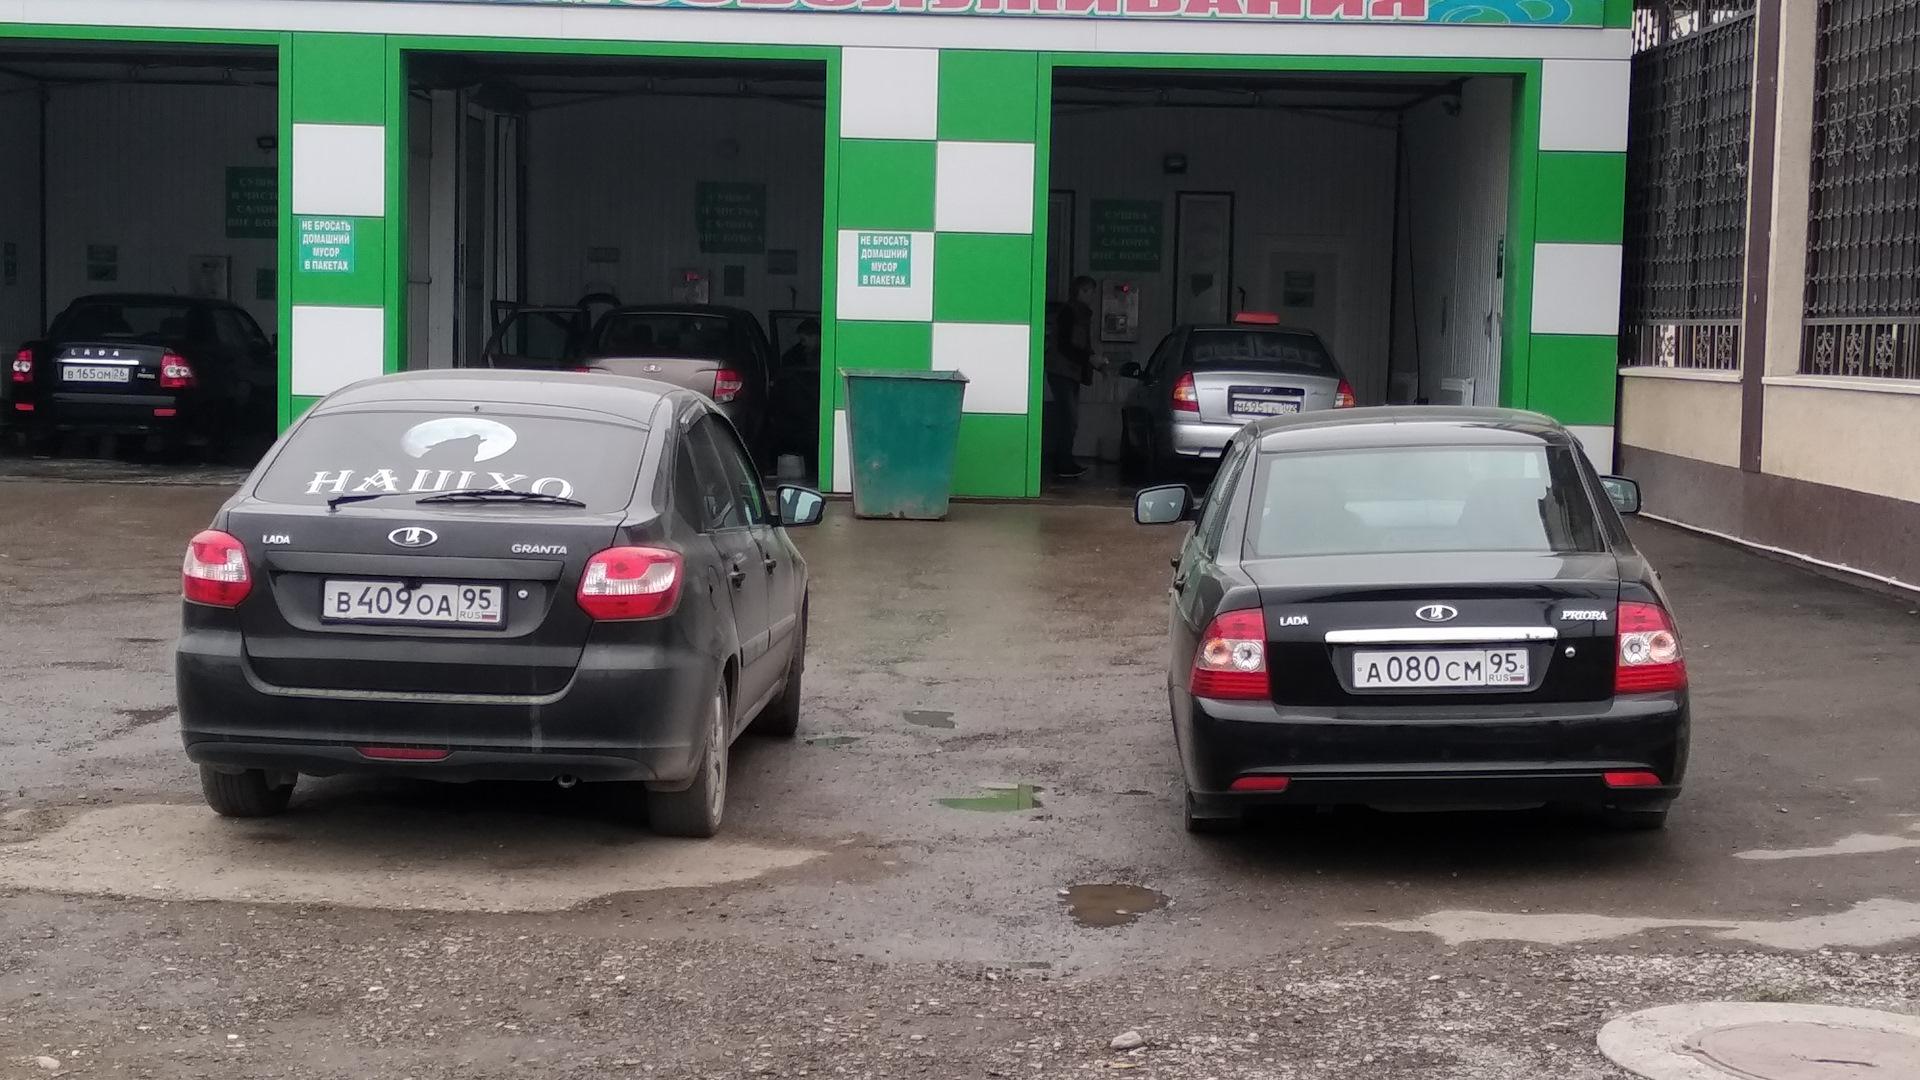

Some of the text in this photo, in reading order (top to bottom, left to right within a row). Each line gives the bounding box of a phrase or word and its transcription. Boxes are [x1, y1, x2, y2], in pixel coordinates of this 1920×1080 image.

[302, 220, 351, 232] НЕ БРОСАТЬ
[302, 232, 350, 245] ДОМАШНИЙ
[860, 235, 909, 246] НЕ БРОСАТЬ
[312, 247, 340, 257] МУСОР
[861, 247, 908, 260] ДОМАШНИЙ
[304, 260, 348, 271] В ПАКЕТАХ
[871, 262, 898, 272] МУСОР
[862, 275, 906, 286] В ПАКЕТАХ
[70, 348, 119, 357] LADA
[262, 534, 291, 545] LADA
[511, 543, 568, 556] GRANTA
[460, 611, 481, 619] RUS
[1561, 609, 1608, 622] PRIORA
[1279, 616, 1309, 627] LADA
[1488, 674, 1510, 682] RUS
